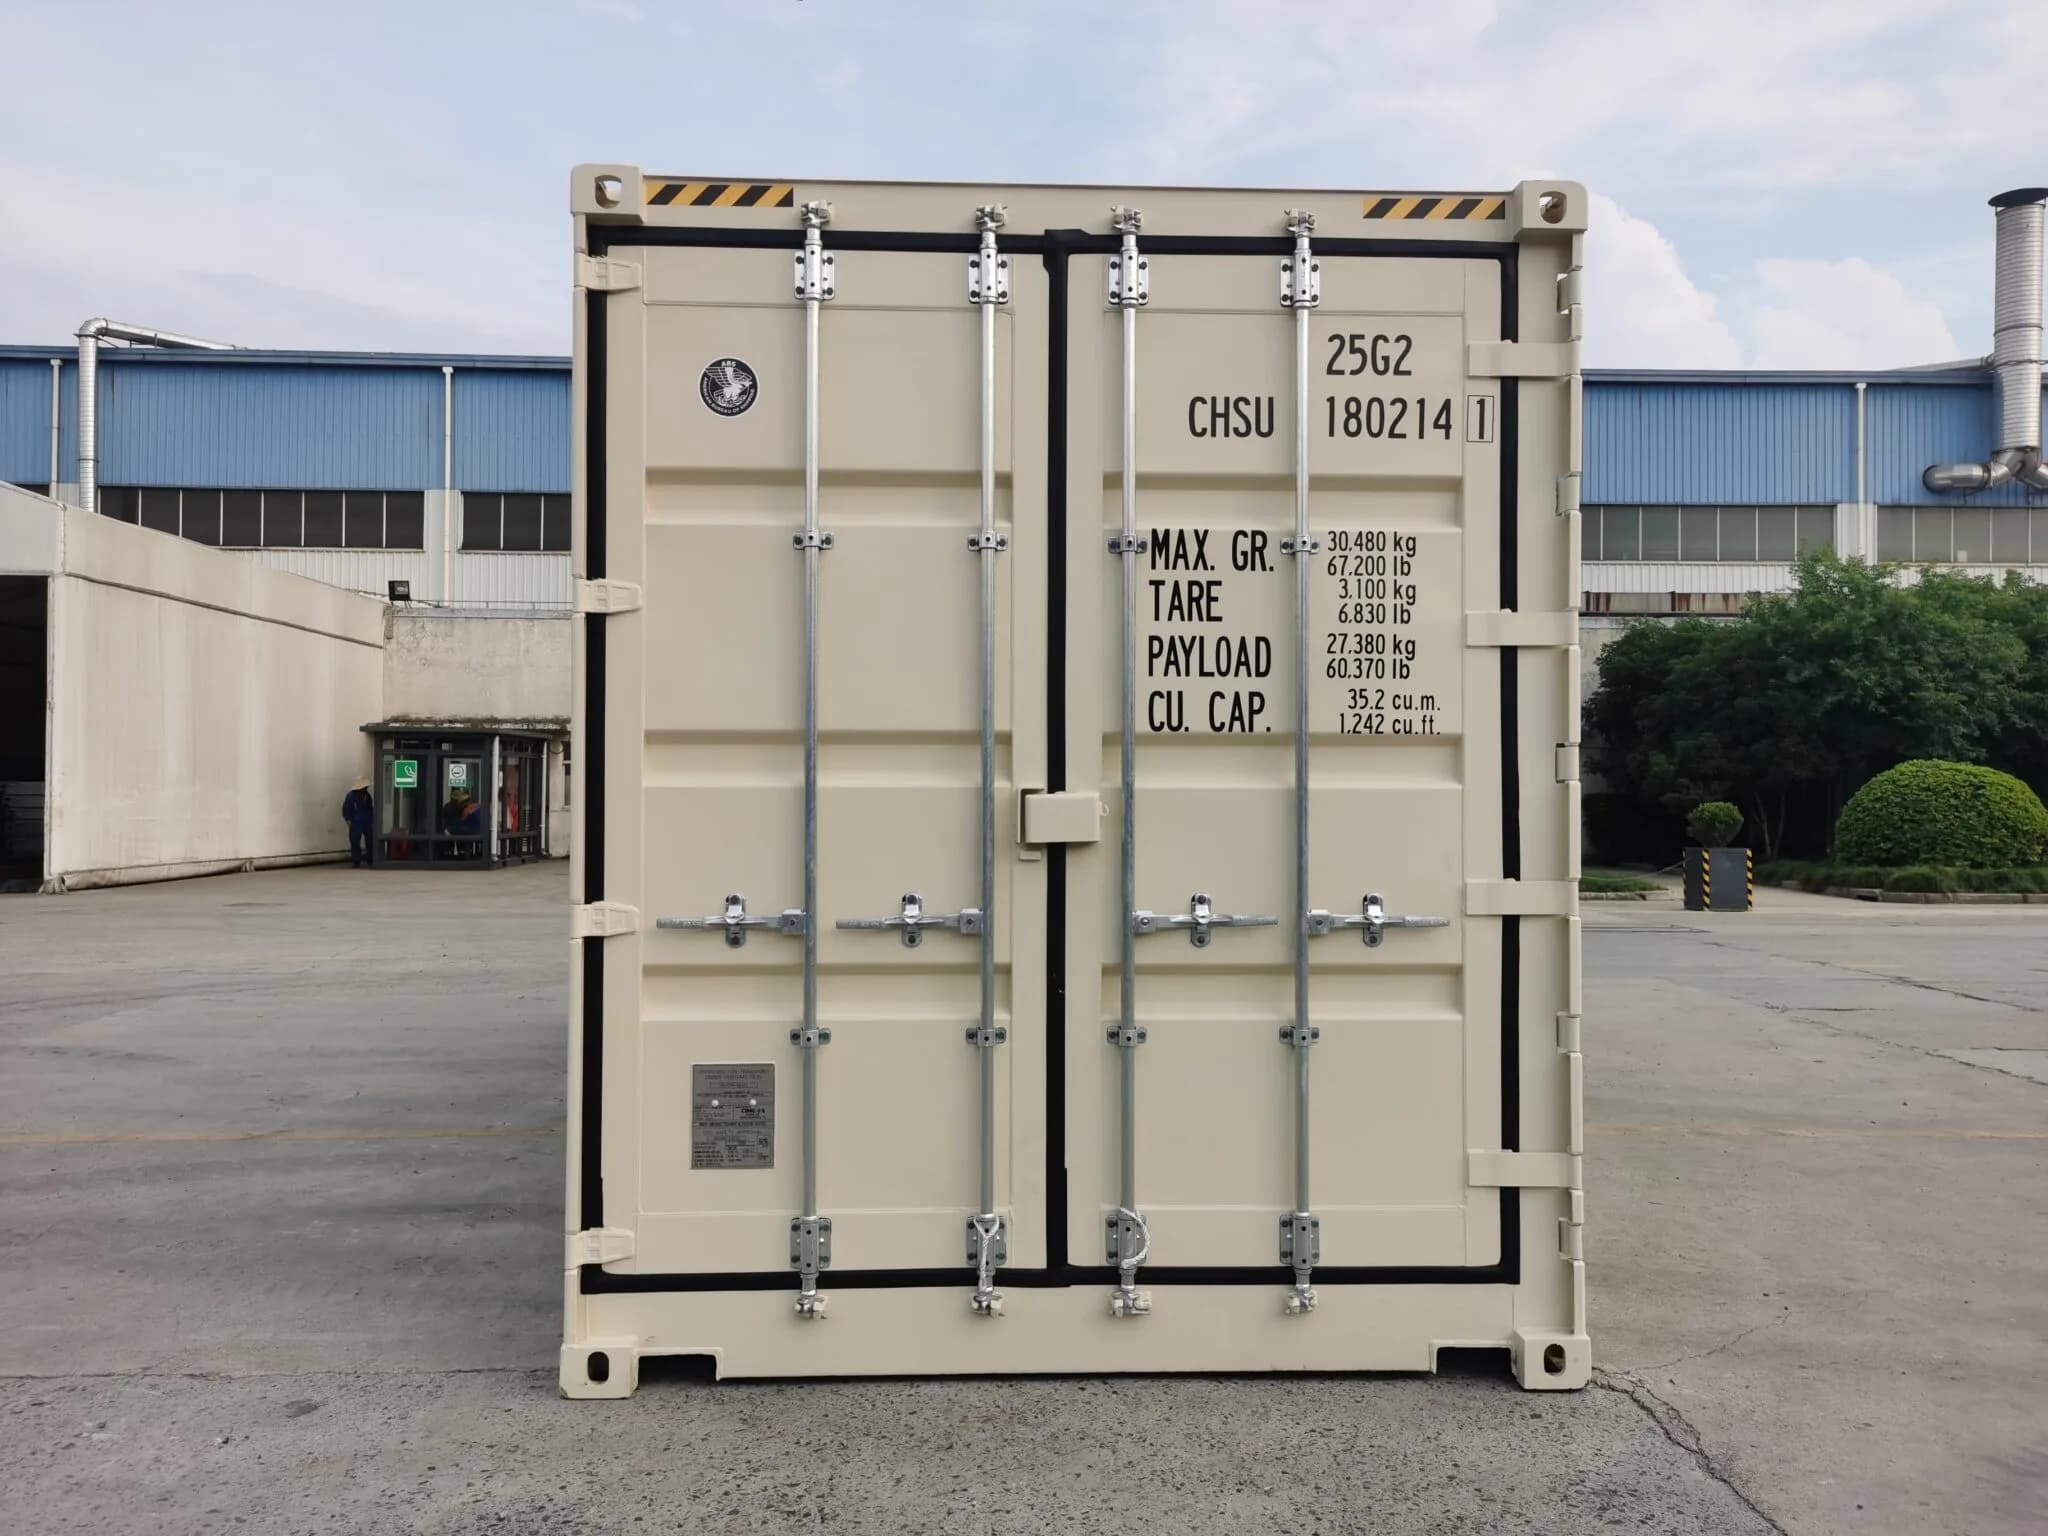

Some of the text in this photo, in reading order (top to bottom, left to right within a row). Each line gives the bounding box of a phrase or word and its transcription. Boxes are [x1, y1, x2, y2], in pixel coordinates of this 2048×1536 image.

[1326, 333, 1413, 376] 25G2
[1188, 396, 1486, 440] CHSU 180214 1
[1151, 528, 1216, 571] MAX.
[1231, 530, 1275, 572] GR.
[1393, 531, 1416, 558] kg
[1393, 555, 1412, 577] lb
[1148, 579, 1223, 622] TARE
[1393, 579, 1416, 606] kg
[1393, 603, 1412, 625] lb
[1148, 634, 1272, 678] PAYLOAD
[1392, 633, 1416, 661] kg
[1392, 658, 1411, 680] lb
[1147, 688, 1441, 733] CU. CAP. 35.2 cu.m.
[1392, 714, 1441, 736] cu.ft.
